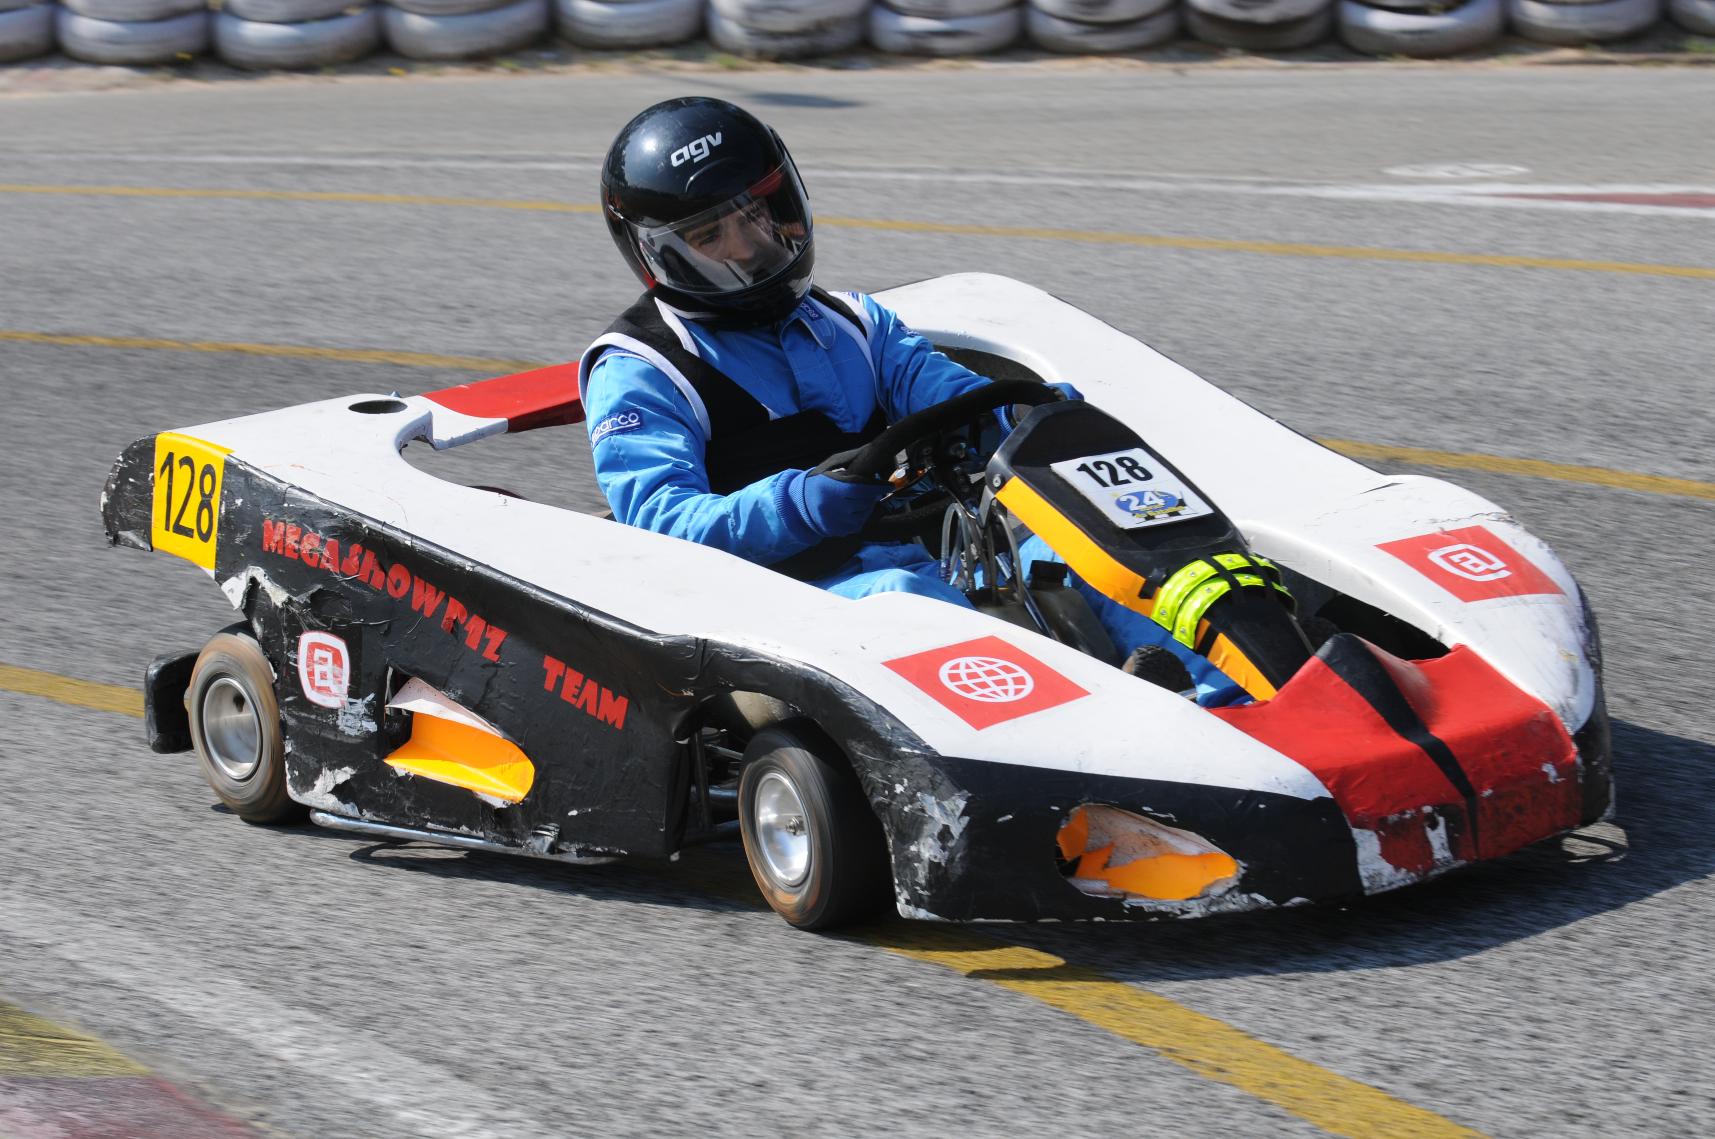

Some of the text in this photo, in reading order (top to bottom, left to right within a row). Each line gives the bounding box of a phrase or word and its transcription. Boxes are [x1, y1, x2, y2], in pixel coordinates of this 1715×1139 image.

[671, 131, 722, 168] agv
[1076, 456, 1153, 487] 128
[158, 451, 217, 543] 128
[1120, 491, 1165, 511] 24
[543, 655, 629, 730] TEAM
